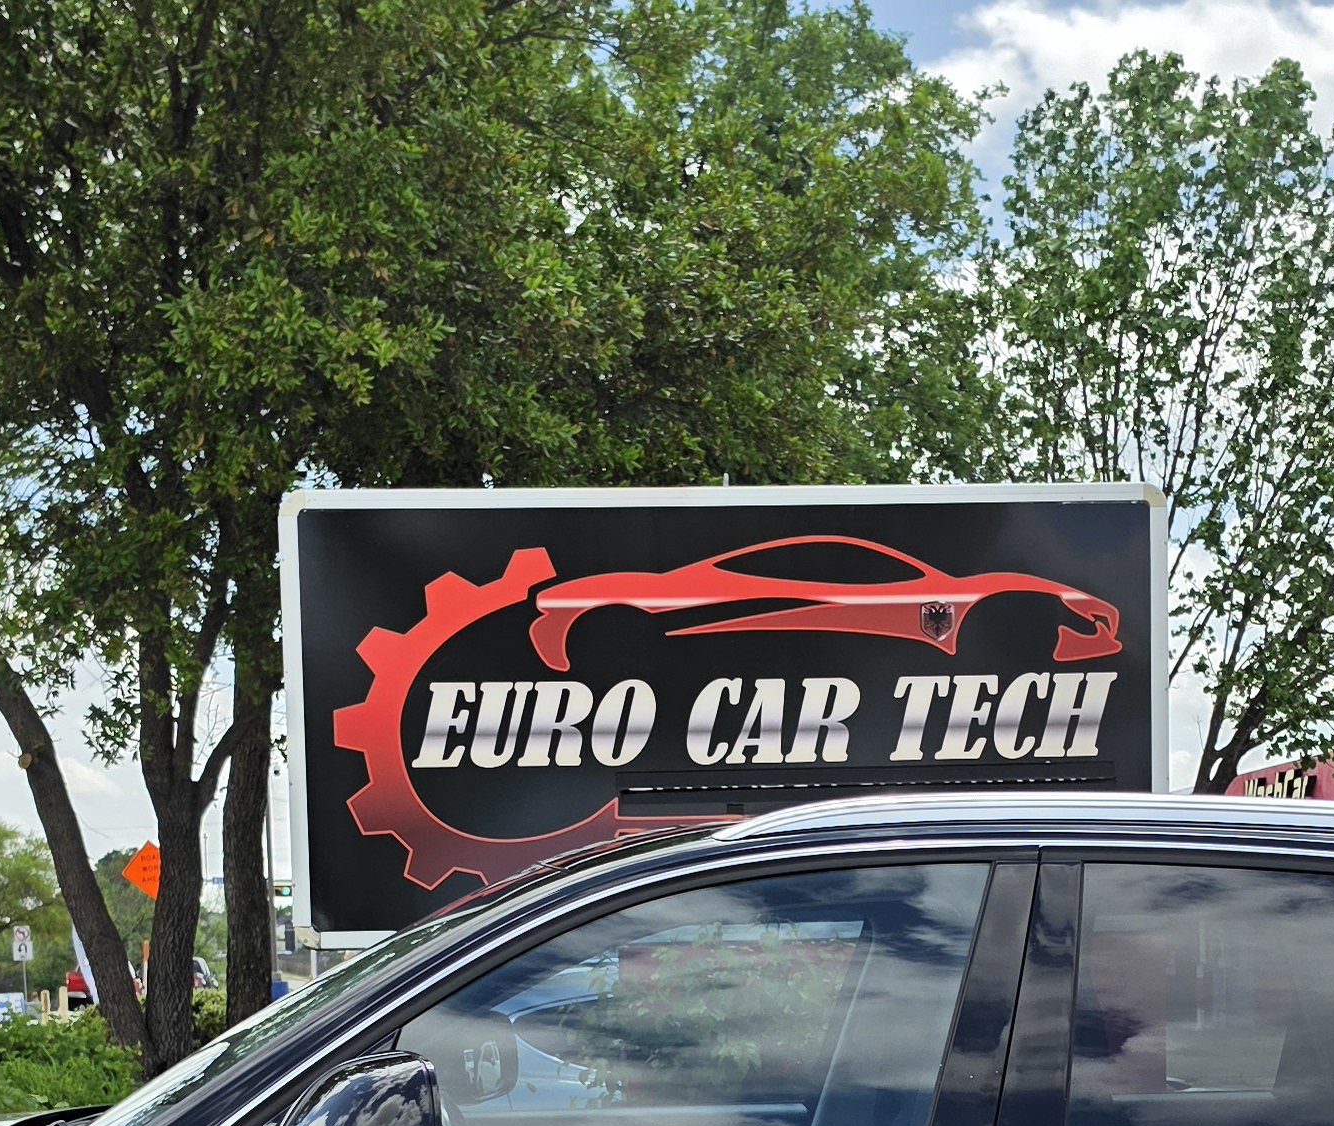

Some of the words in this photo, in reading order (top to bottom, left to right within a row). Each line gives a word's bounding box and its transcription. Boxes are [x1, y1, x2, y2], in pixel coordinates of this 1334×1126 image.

[411, 679, 656, 768] EURO
[686, 677, 861, 766] CAR
[889, 672, 1118, 761] TECH
